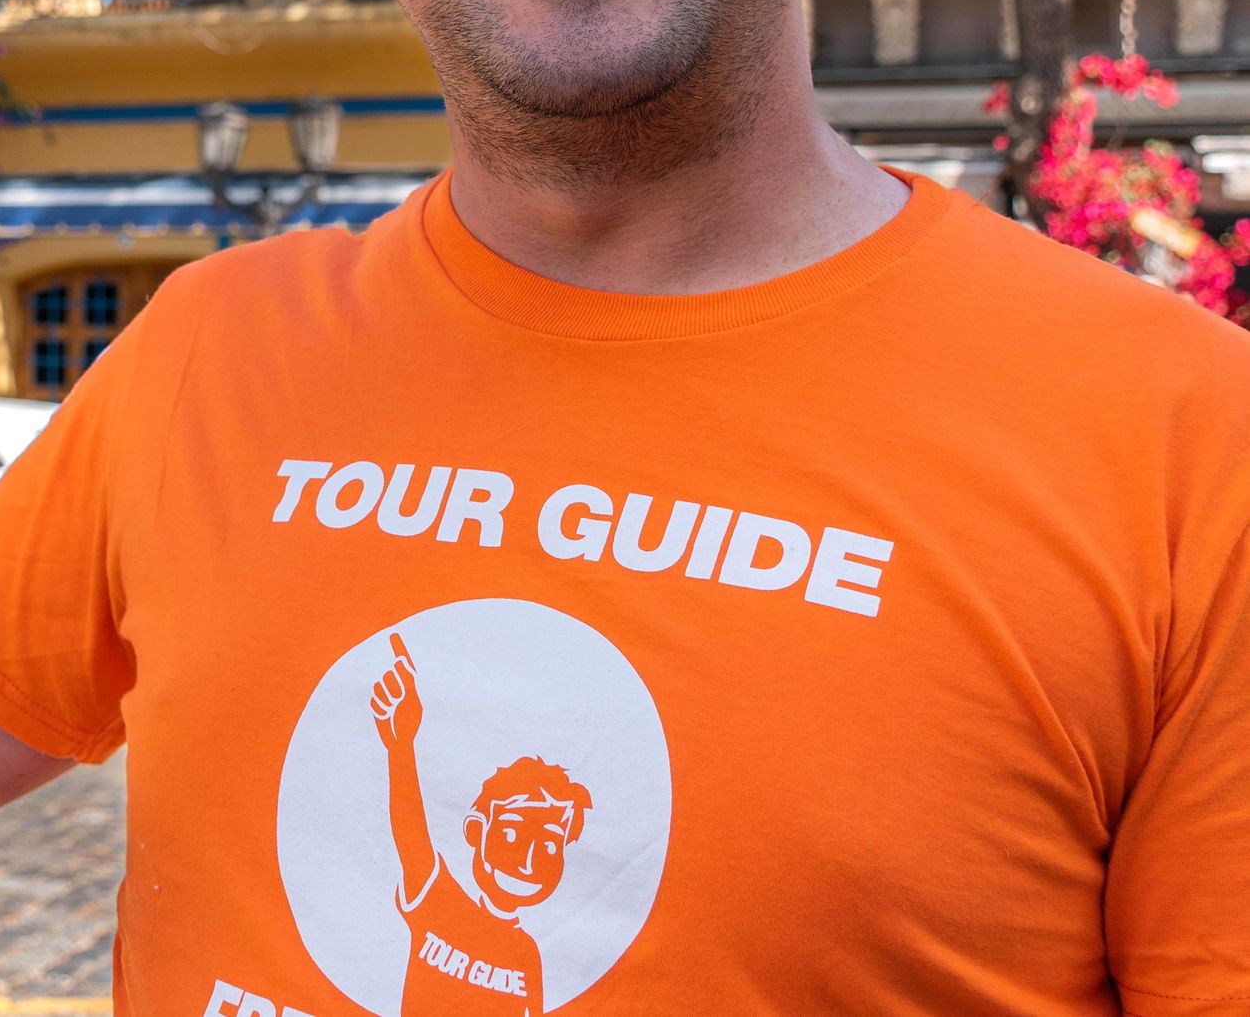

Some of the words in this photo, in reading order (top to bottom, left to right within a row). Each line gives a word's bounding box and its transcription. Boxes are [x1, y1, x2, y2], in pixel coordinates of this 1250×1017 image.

[272, 459, 514, 547] TOUR
[538, 484, 894, 617] GUIDE
[418, 930, 469, 980] TOUR
[467, 959, 528, 998] GUIDE
